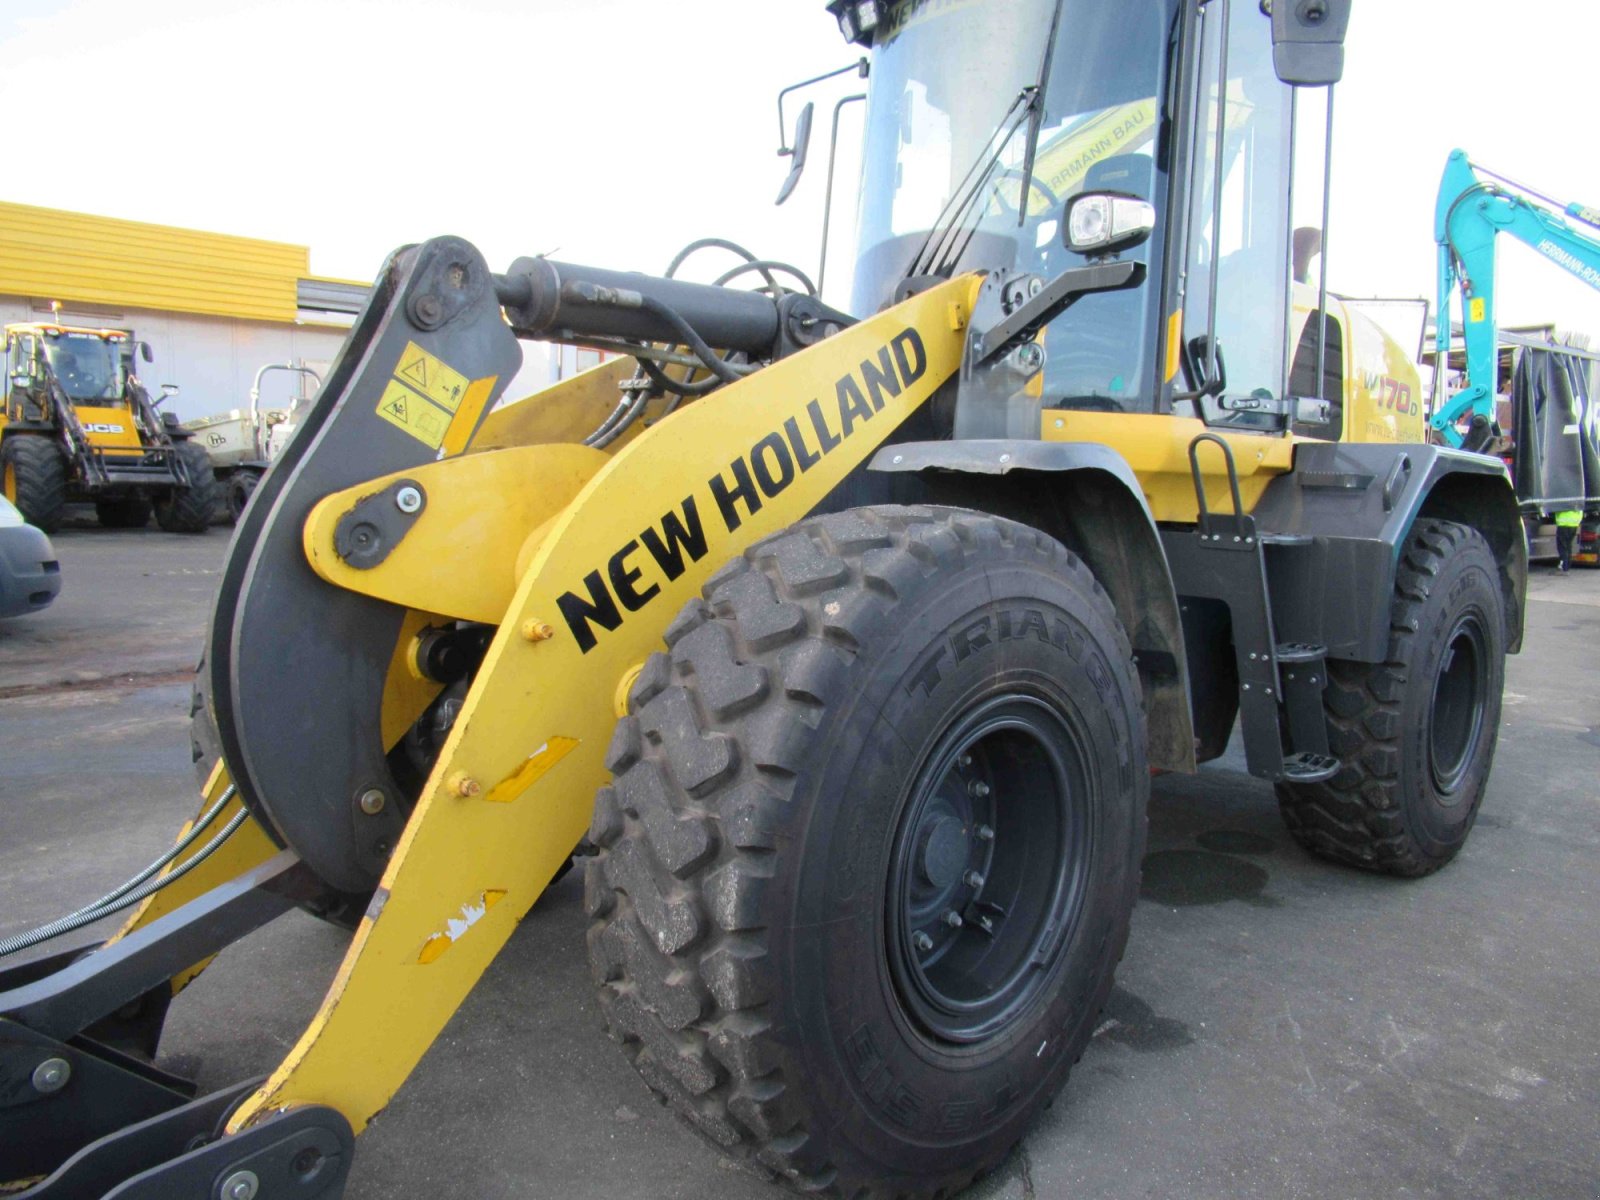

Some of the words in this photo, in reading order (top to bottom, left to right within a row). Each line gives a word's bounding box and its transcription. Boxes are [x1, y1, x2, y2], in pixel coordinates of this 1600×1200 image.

[1113, 110, 1145, 140] BAU
[83, 423, 125, 434] JCB
[556, 495, 709, 654] NEW
[708, 326, 928, 533] HOLLAND
